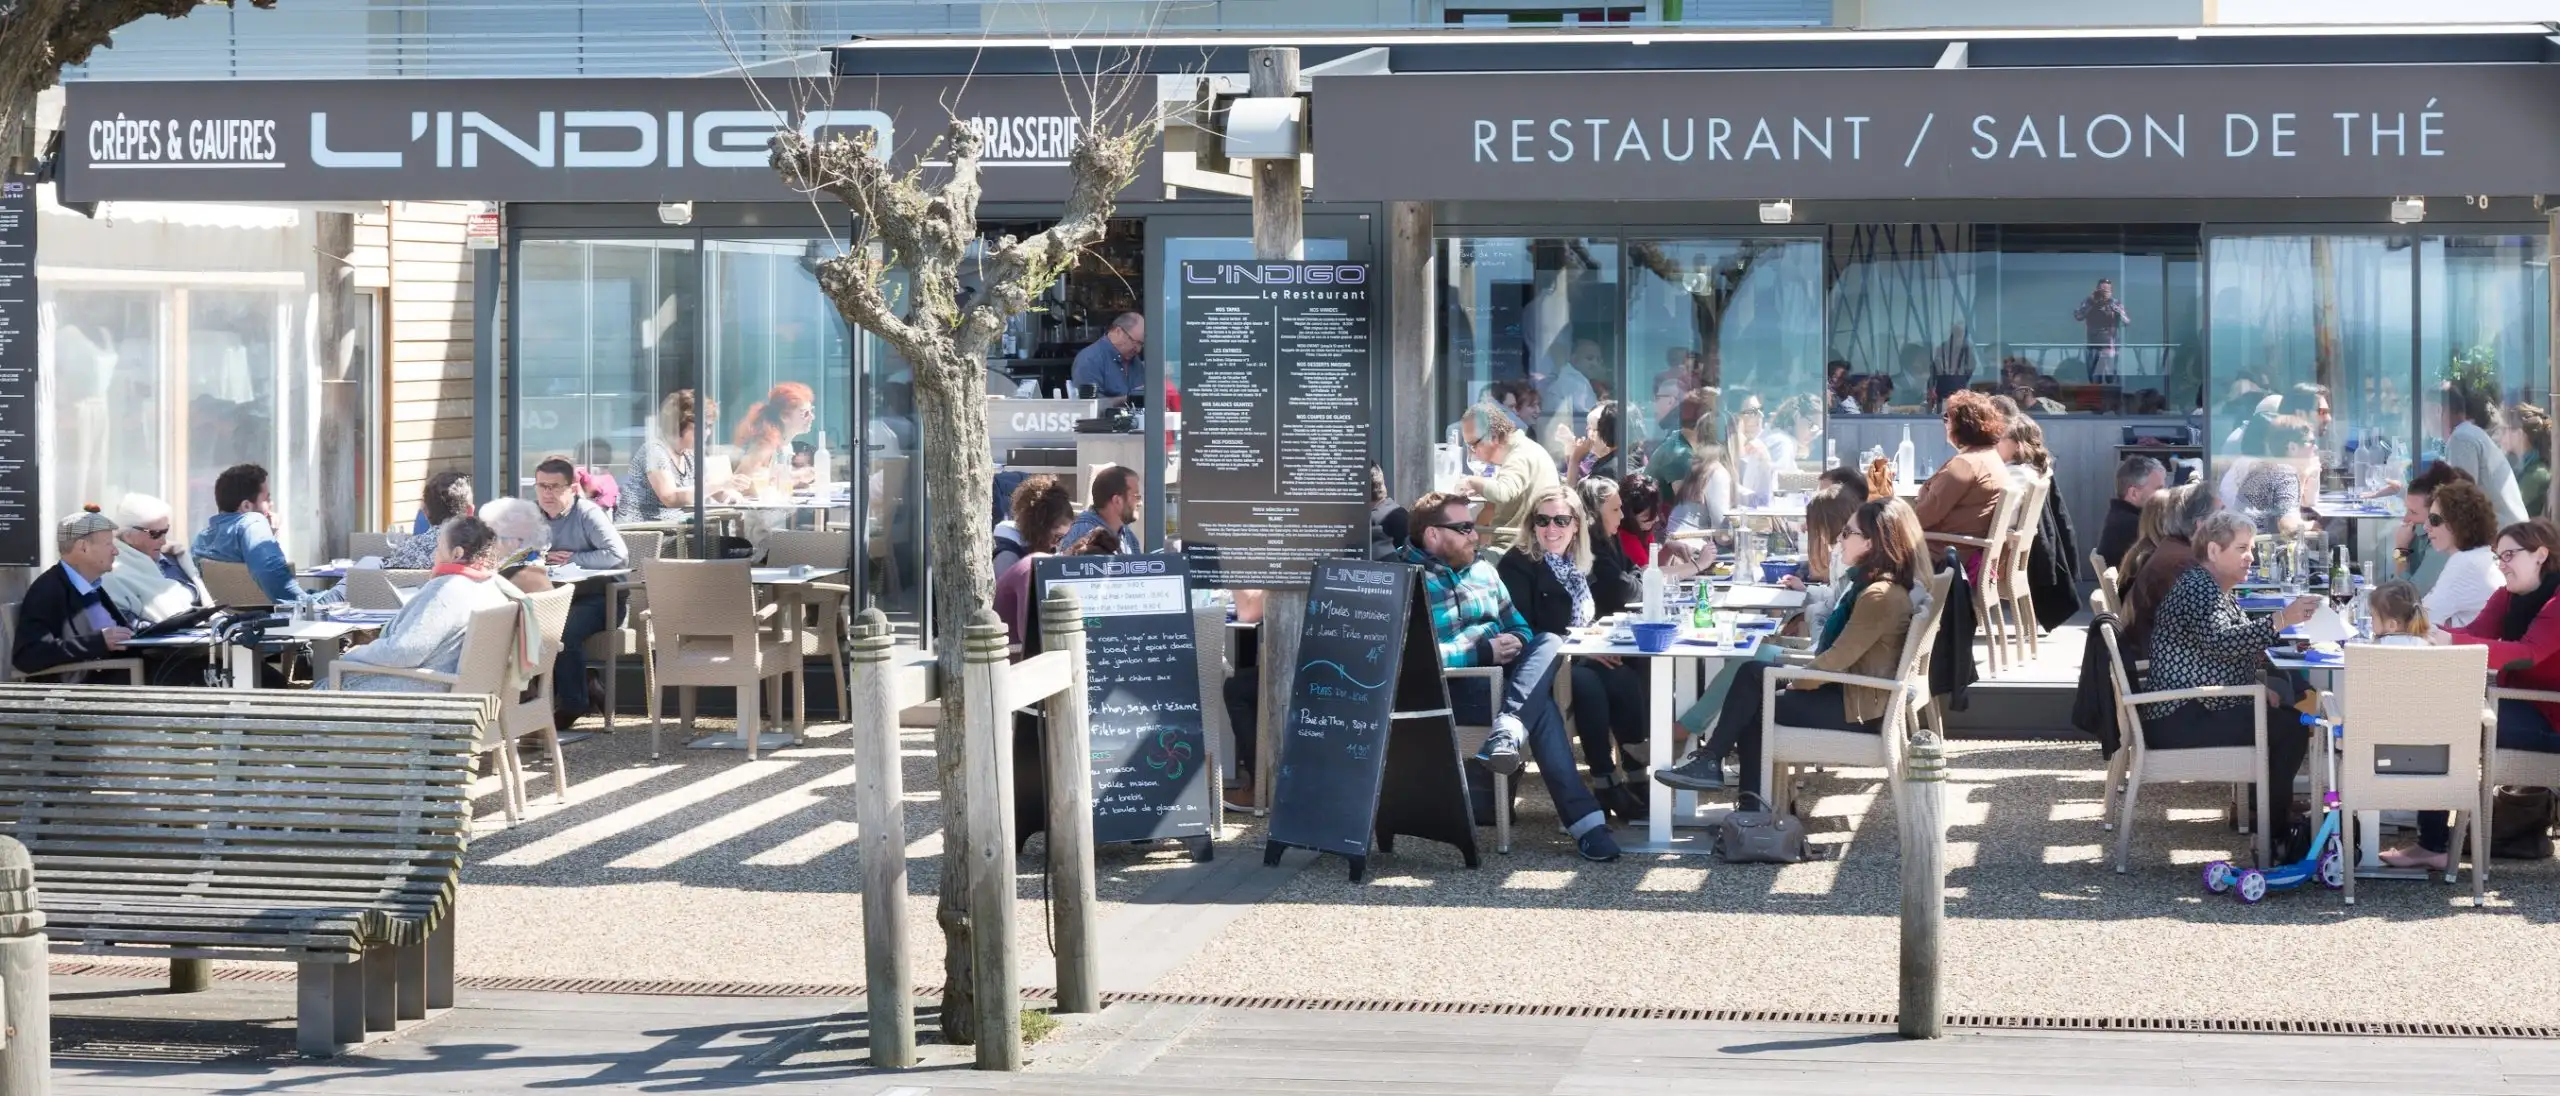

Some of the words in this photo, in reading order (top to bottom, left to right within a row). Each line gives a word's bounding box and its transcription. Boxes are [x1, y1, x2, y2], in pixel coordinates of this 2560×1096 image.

[89, 112, 161, 160] CRÊPES
[167, 119, 184, 160] &
[189, 119, 276, 160] GAUFRES
[1475, 117, 1870, 162] RESTAURANT
[1971, 113, 2186, 160] SALON
[2226, 113, 2296, 157] DE
[2333, 97, 2444, 156] THÉ
[1187, 265, 1365, 285] L'INDIGO
[1262, 290, 1278, 300] Le
[1284, 290, 1365, 300] Restaurant
[1061, 560, 1166, 577] L'INDIGO
[1326, 567, 1395, 585] L'INDIGO
[1357, 586, 1392, 595] Suggestions
[1321, 600, 1350, 619] Moules
[1103, 644, 1128, 655] boeuf
[1113, 657, 1143, 669] jambon
[1166, 654, 1177, 662] de
[1152, 700, 1162, 711] et
[1165, 701, 1200, 711] sésame
[1106, 765, 1137, 773] maison
[1103, 794, 1113, 803] de
[1100, 807, 1107, 816] 2
[1113, 805, 1137, 813] boules
[1142, 804, 1152, 812] de
[1156, 804, 1181, 816] glaces
